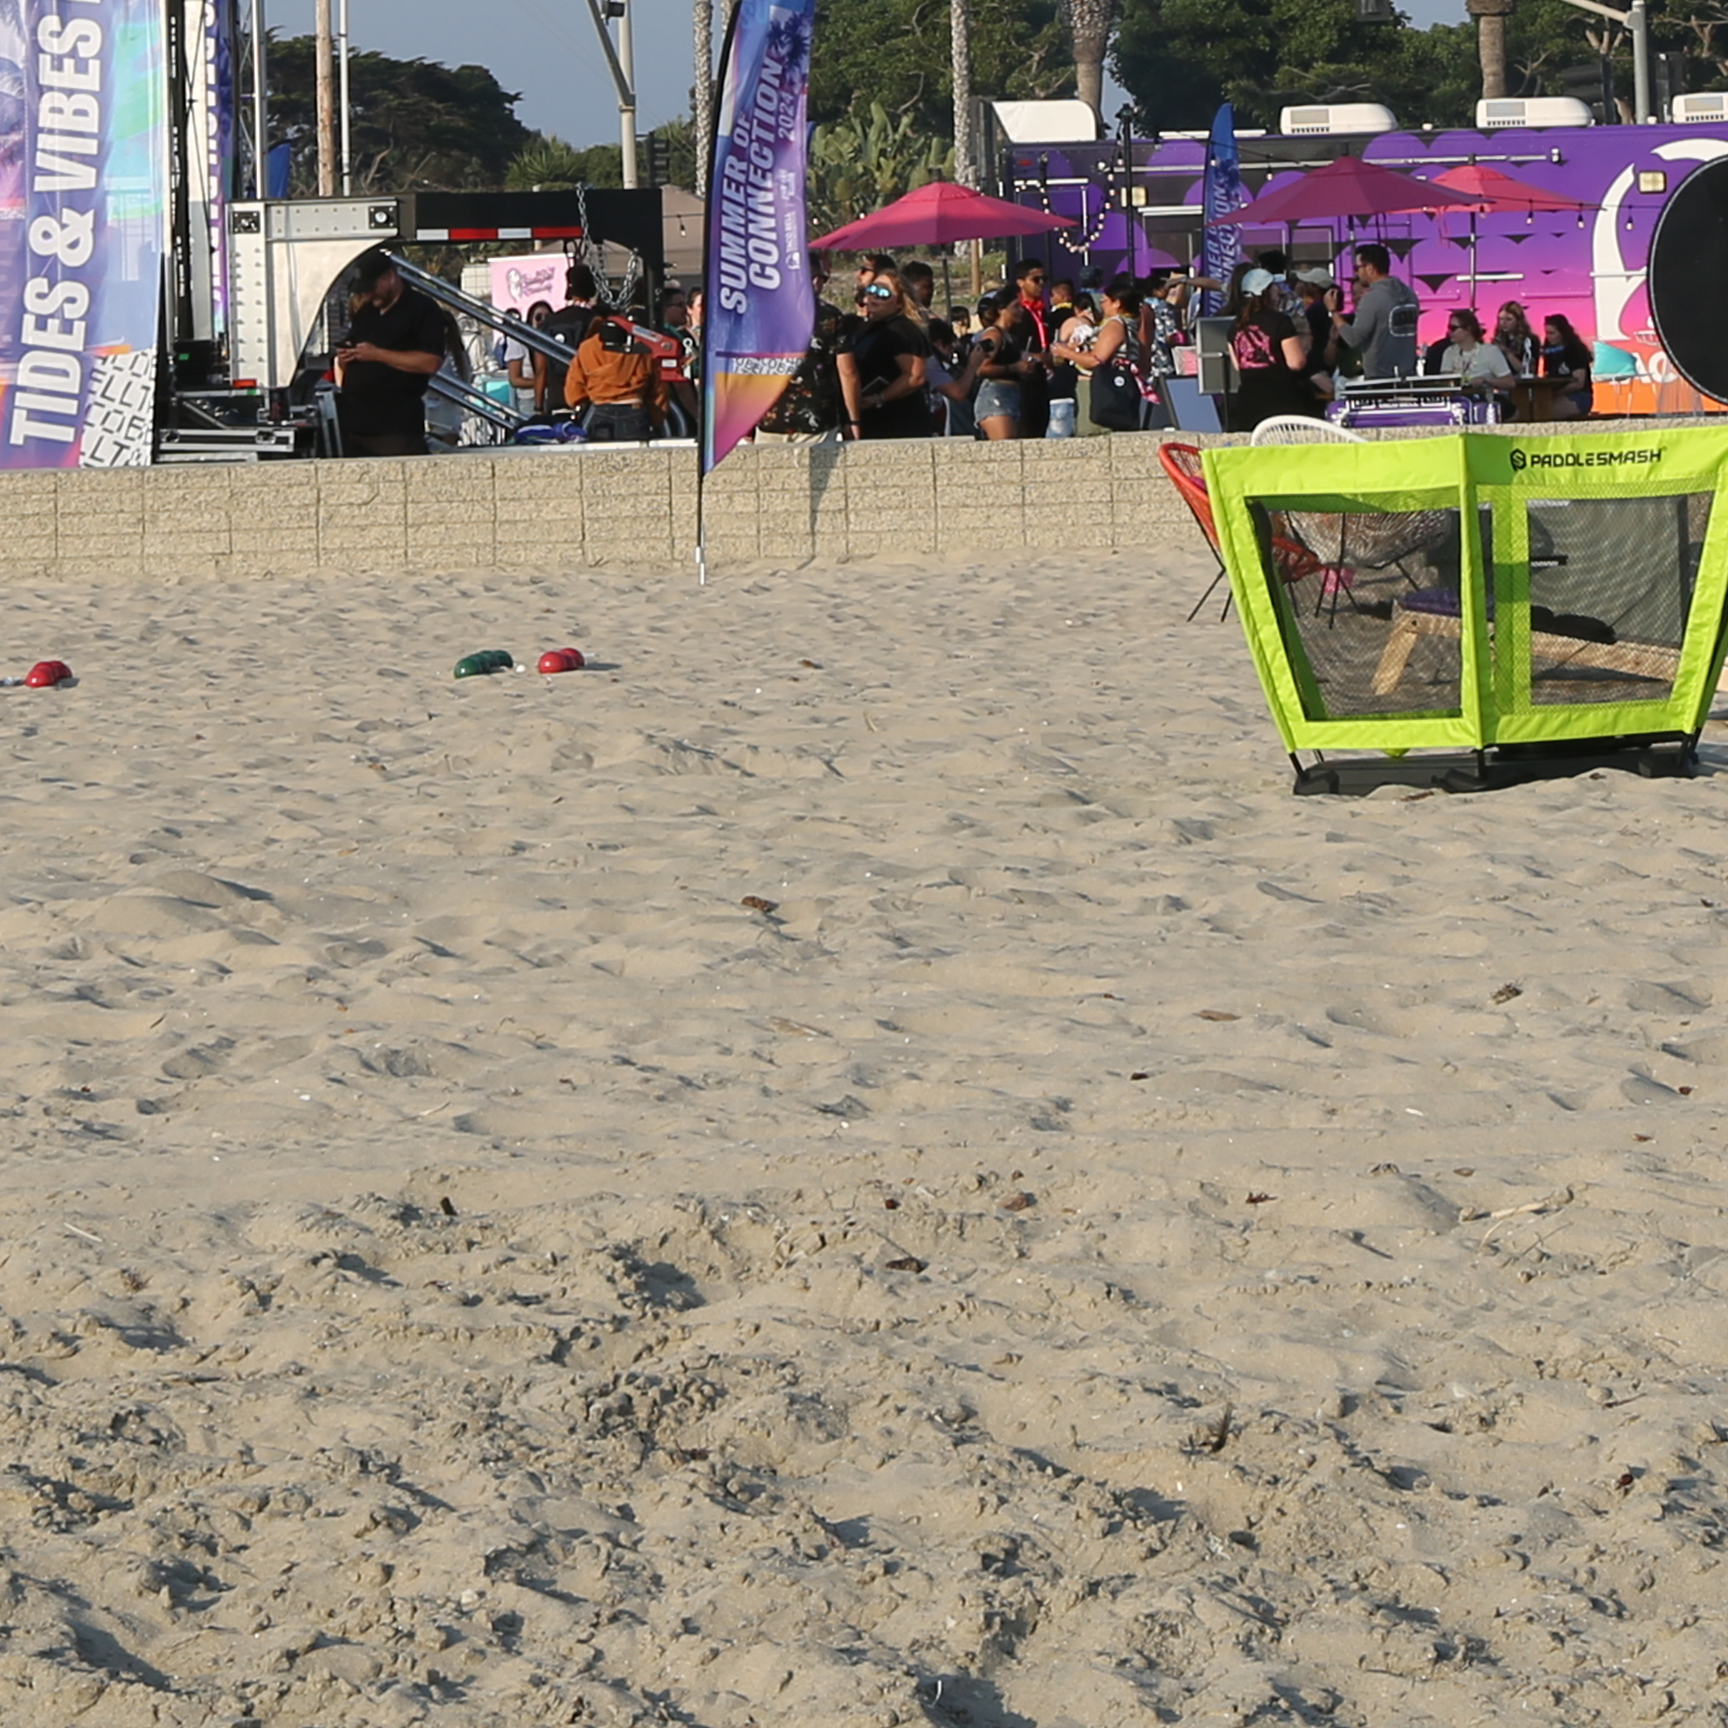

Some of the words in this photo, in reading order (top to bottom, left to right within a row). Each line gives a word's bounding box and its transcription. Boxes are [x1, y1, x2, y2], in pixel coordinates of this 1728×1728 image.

[33, 14, 103, 192] VIBES
[733, 114, 752, 148] OF
[778, 94, 796, 142] 2024
[747, 56, 784, 291] CONNECTION
[28, 207, 95, 267] &
[720, 153, 748, 315] SUMMER
[9, 276, 90, 446] TIDES
[1530, 447, 1662, 468] PADDLESMASH
